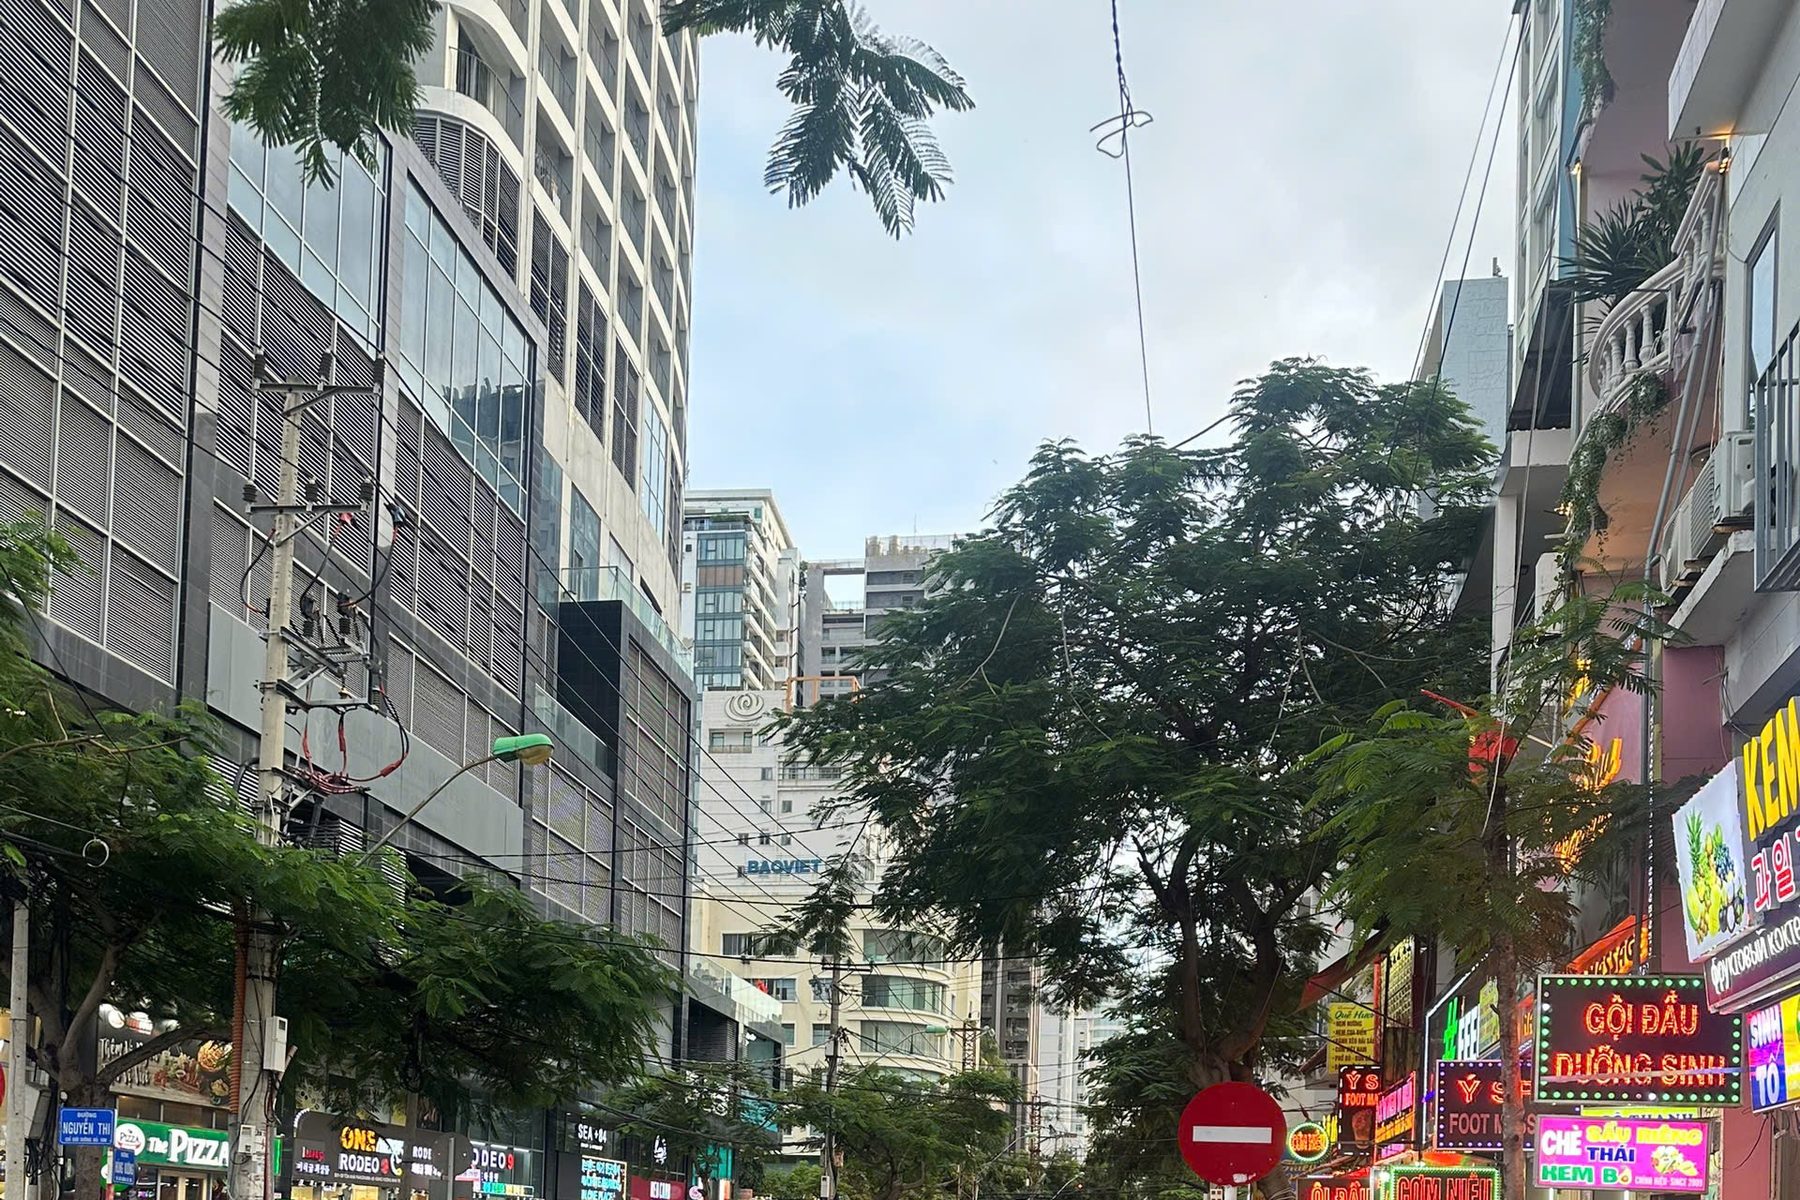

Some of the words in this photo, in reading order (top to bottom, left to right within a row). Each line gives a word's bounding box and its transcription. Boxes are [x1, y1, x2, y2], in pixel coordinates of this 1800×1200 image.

[1751, 825, 1800, 912] 과일
[1750, 1004, 1782, 1048] SINH
[1344, 1093, 1366, 1106] FOOT
[578, 1123, 593, 1141] SEA
[1449, 1112, 1490, 1135] FOOT
[167, 1129, 229, 1166] PIZZA
[1541, 1125, 1583, 1156] CHÈ
[1586, 1144, 1635, 1163] THÁI
[1541, 1165, 1594, 1183] KEM
